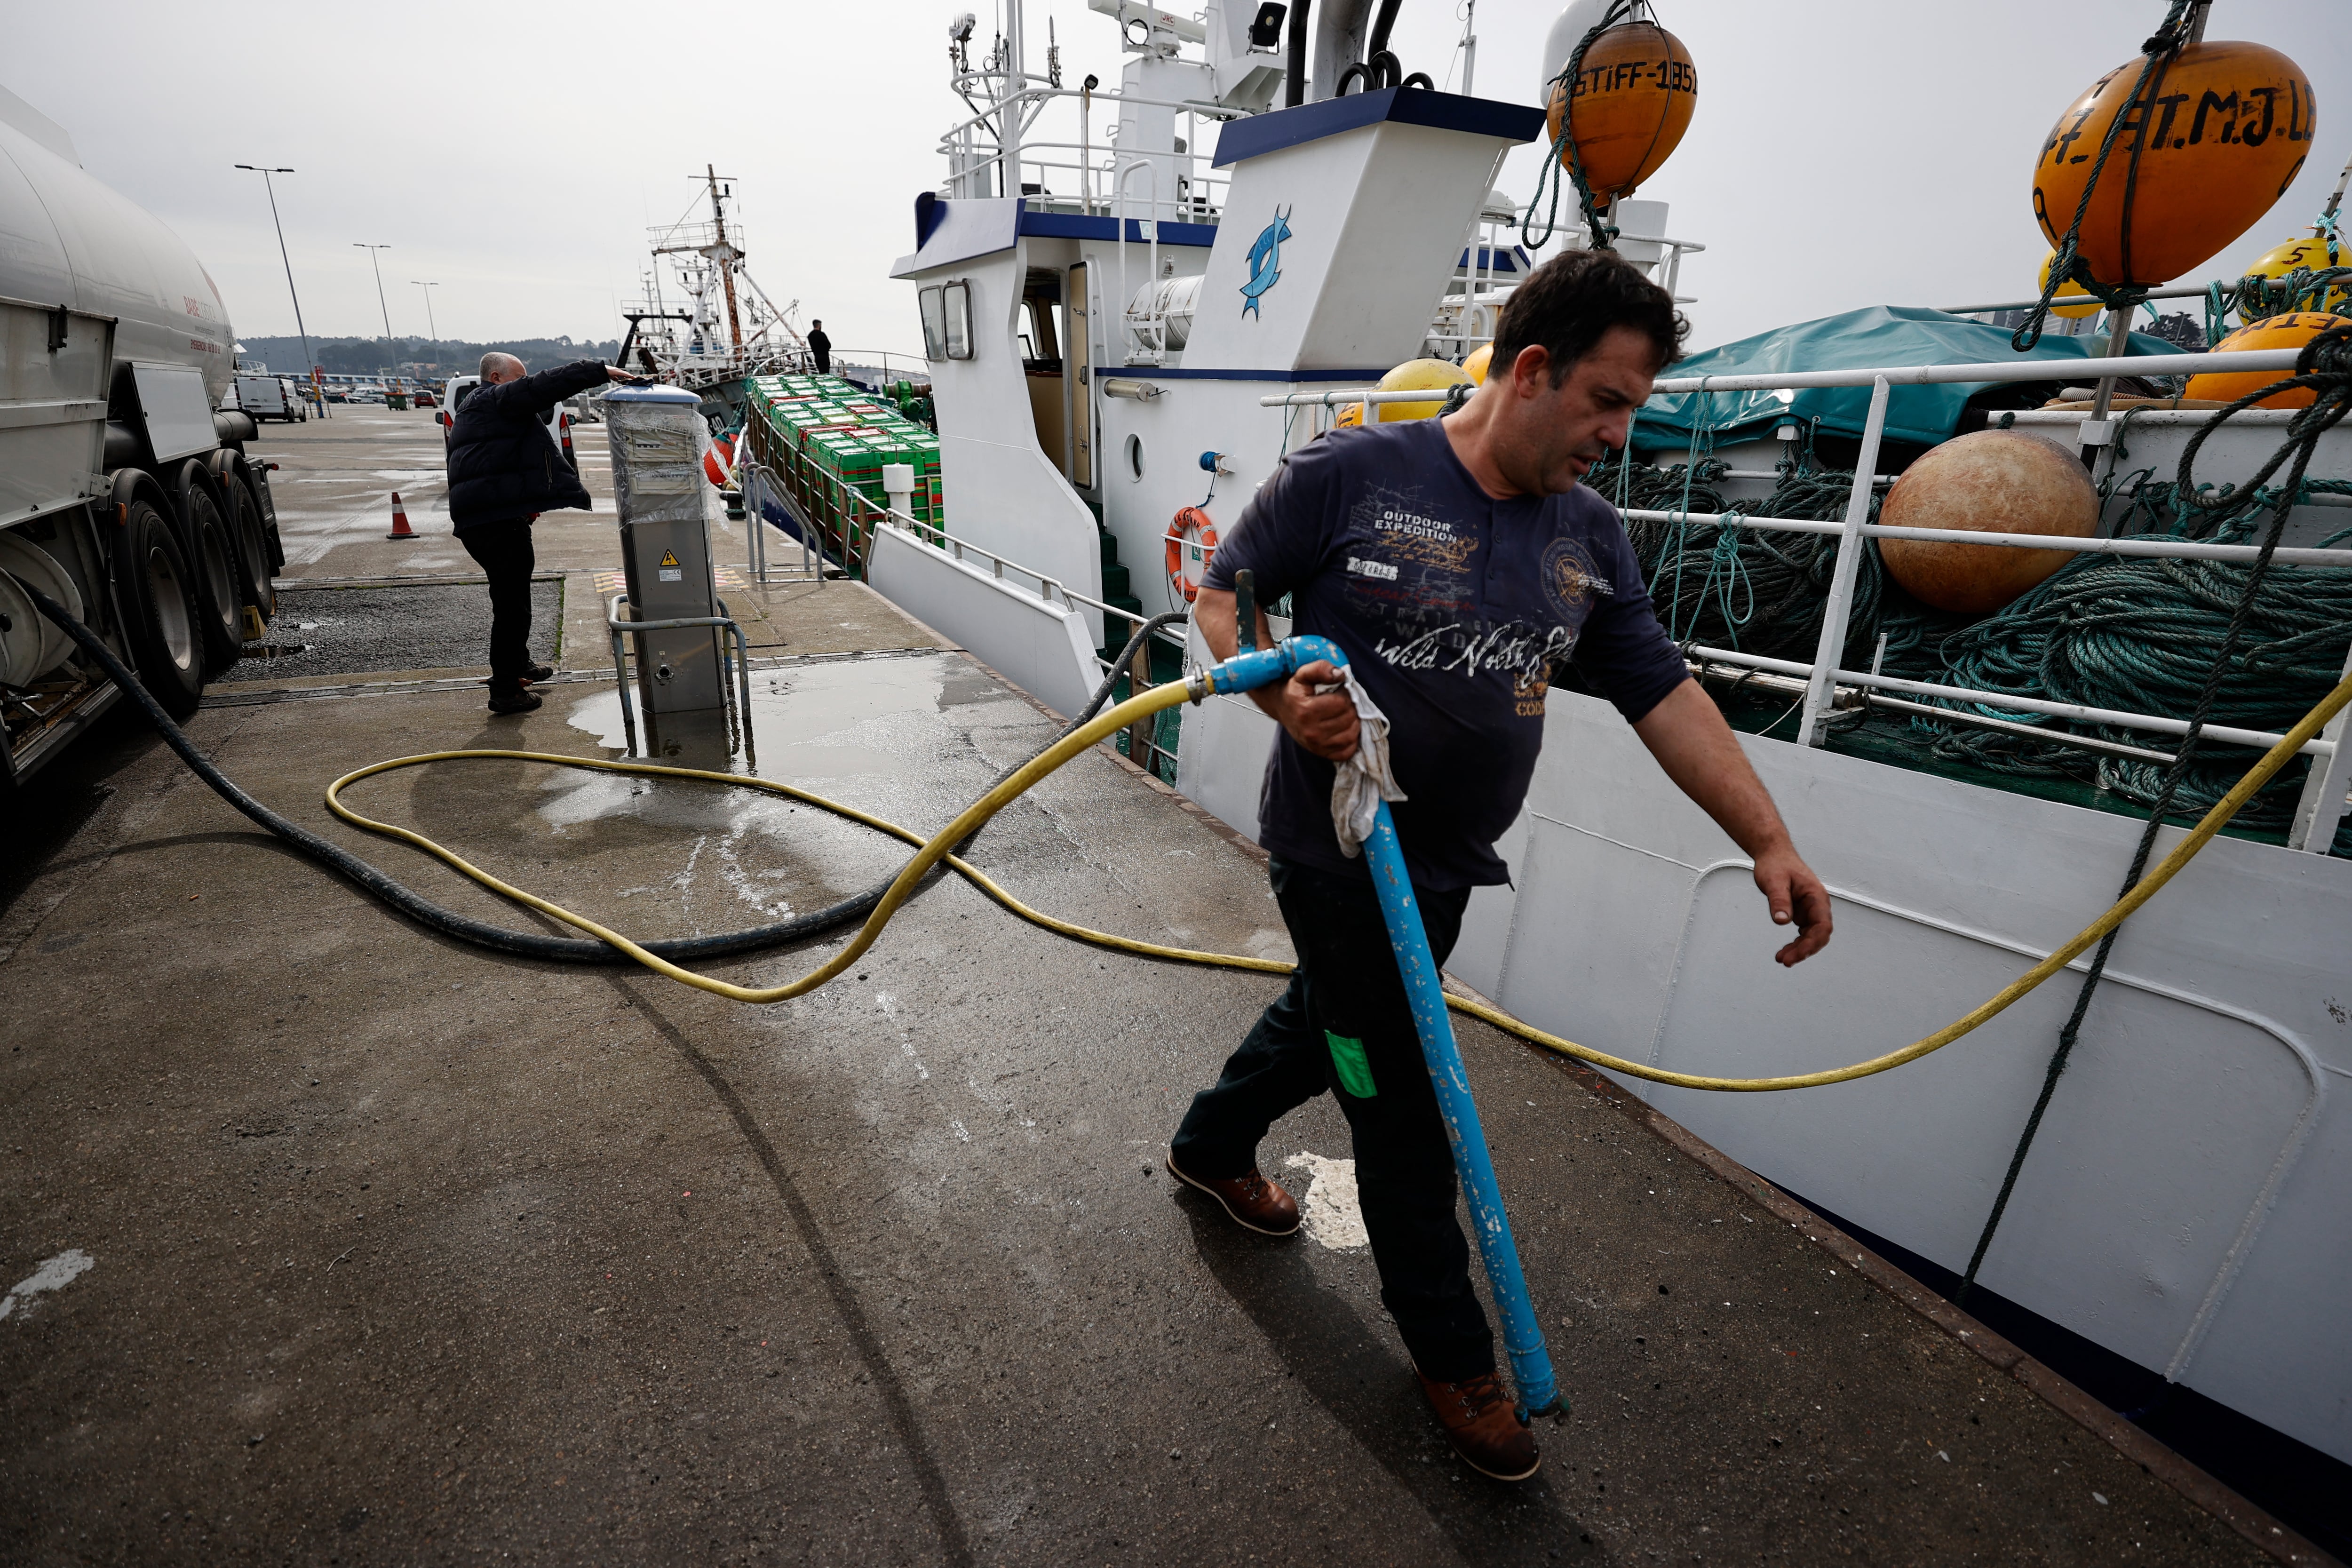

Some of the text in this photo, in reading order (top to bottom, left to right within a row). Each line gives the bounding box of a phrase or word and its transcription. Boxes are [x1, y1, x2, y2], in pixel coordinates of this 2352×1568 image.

[1162, 14, 1174, 23] JRC
[1375, 519, 1457, 543] EXPEDITION
[1383, 510, 1451, 533] OUTDOOR
[1374, 623, 1461, 670] Wild
